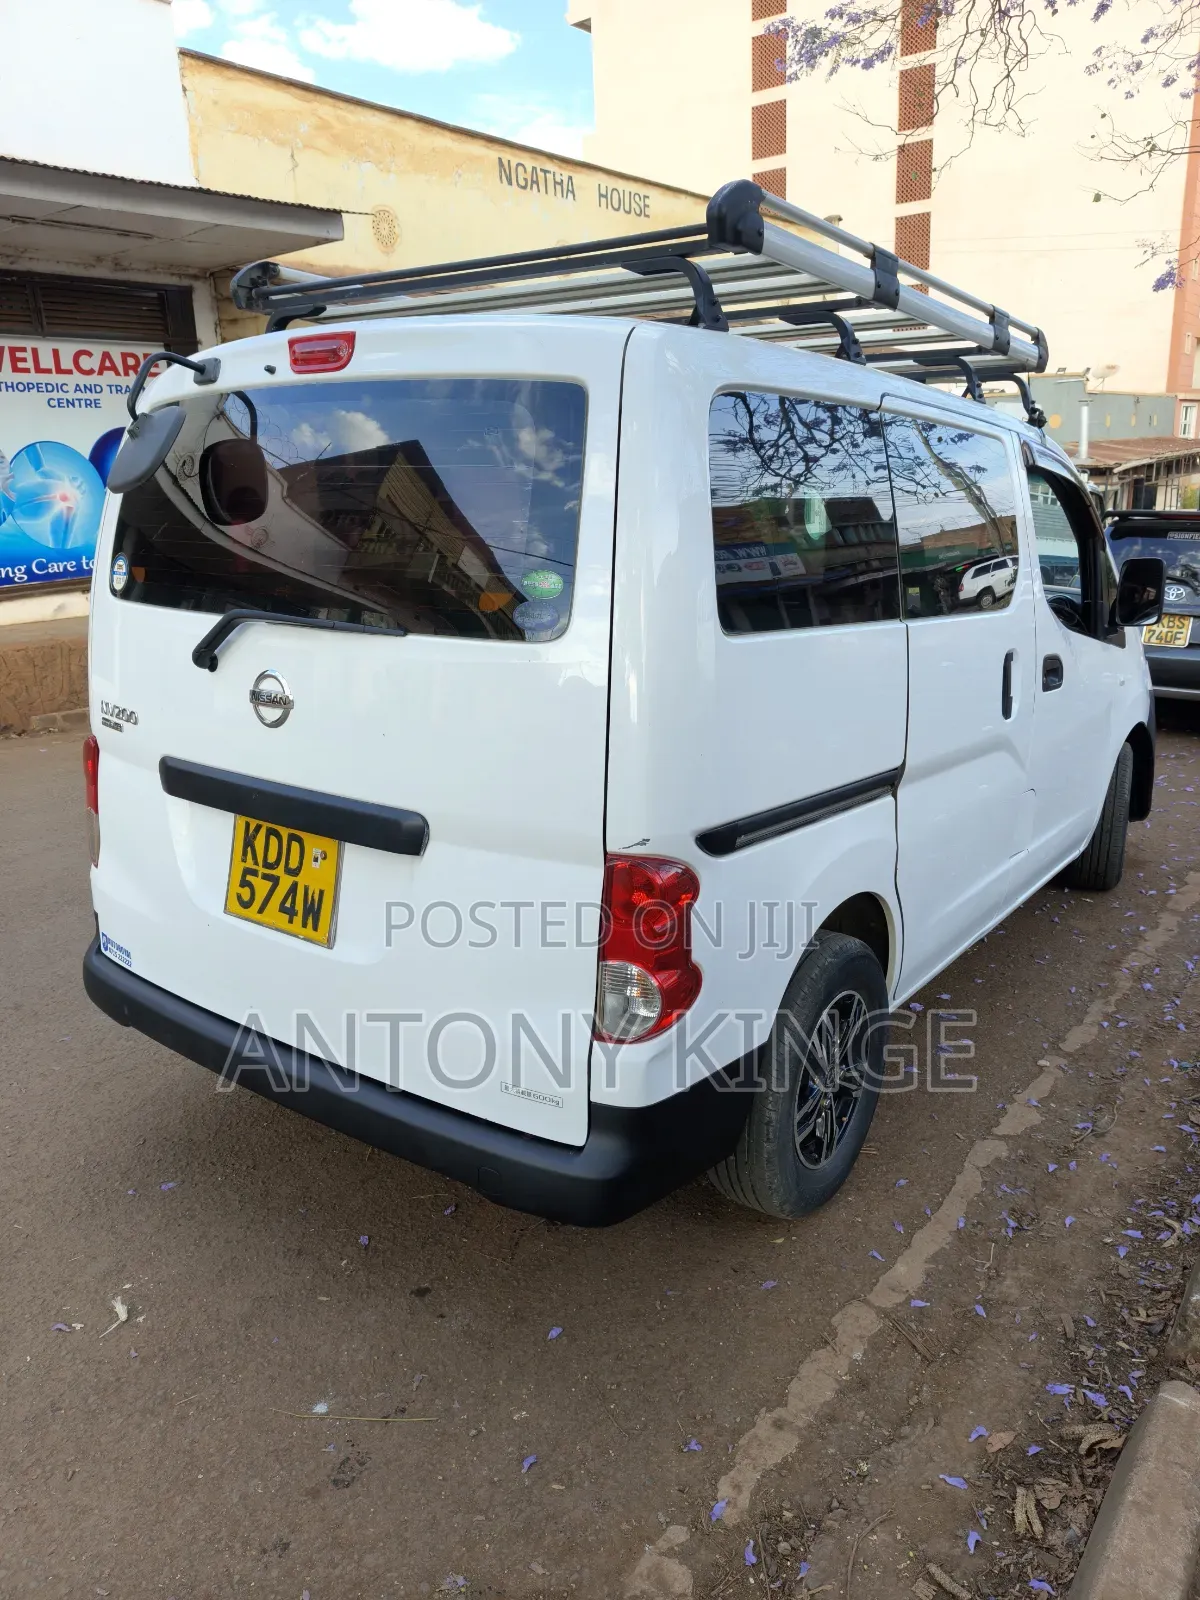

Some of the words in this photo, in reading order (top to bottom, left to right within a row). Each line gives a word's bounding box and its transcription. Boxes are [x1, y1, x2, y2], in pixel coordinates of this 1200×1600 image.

[498, 156, 576, 201] NGATHA
[598, 183, 650, 218] HOUSE
[0, 346, 162, 378] ELLCAR
[73, 383, 104, 394] AND
[47, 397, 102, 409] CENTRE
[31, 558, 77, 575] Care
[250, 689, 288, 707] NISSAN
[101, 700, 138, 726] NV200
[241, 820, 305, 878] KDD
[236, 866, 325, 932] 574W
